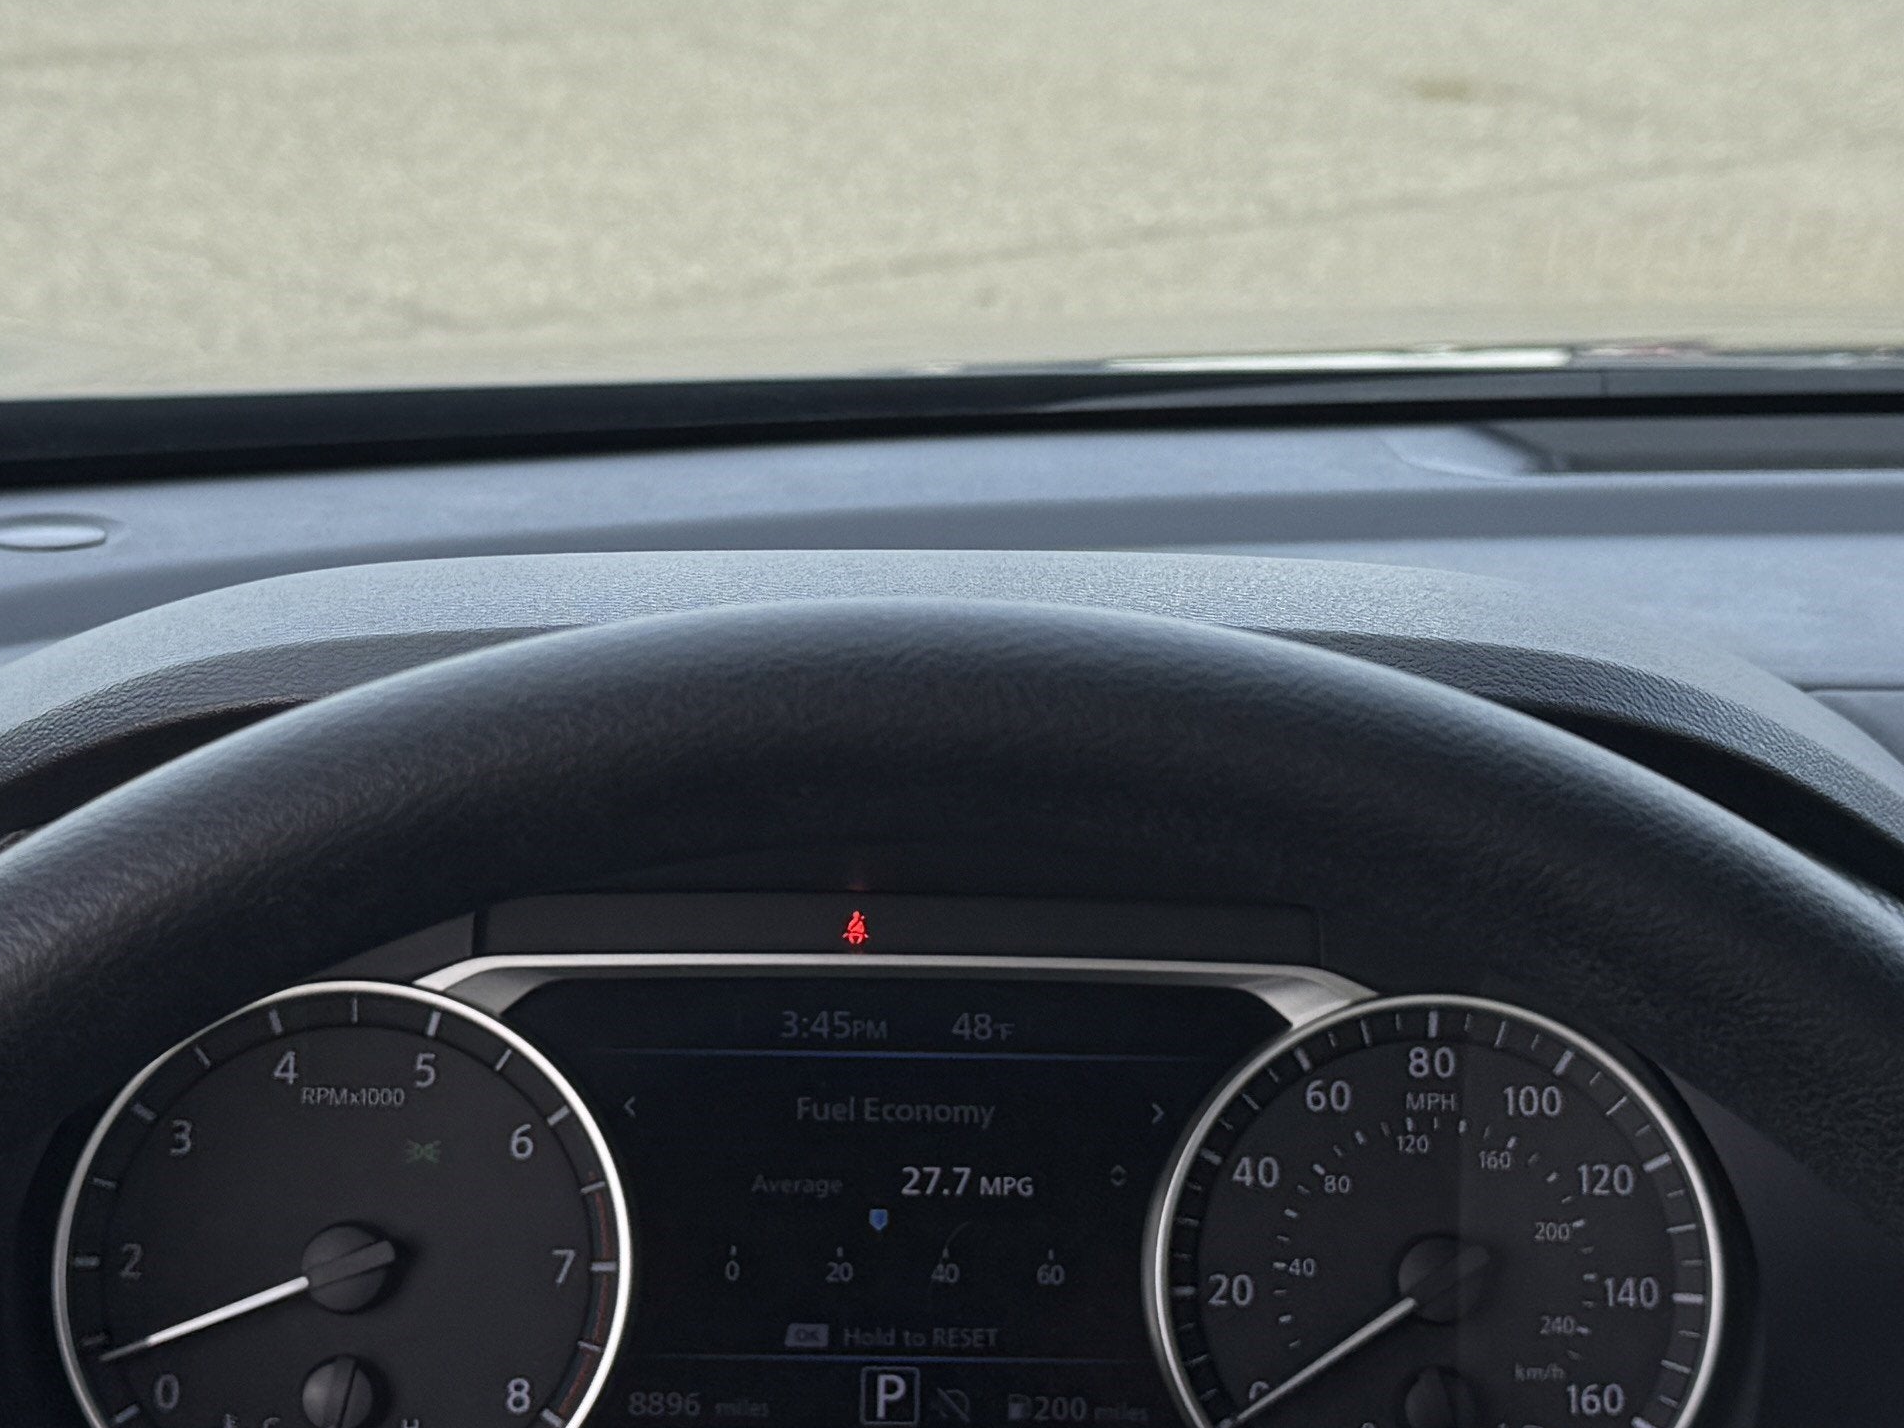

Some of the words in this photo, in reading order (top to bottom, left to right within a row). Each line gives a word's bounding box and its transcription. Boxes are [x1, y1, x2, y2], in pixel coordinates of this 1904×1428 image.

[273, 1050, 298, 1085] 4
[415, 1052, 436, 1087] 5
[1408, 1046, 1457, 1078] 80
[301, 1086, 406, 1106] RPMx1000
[1306, 1080, 1352, 1113] 60
[1406, 1092, 1457, 1112] MPH
[1503, 1085, 1562, 1117] 100
[796, 1097, 855, 1122] Fuel
[864, 1098, 995, 1129] Economy
[170, 1119, 192, 1156] 3
[510, 1124, 534, 1159] 6
[1396, 1134, 1430, 1155] 120
[1232, 1157, 1280, 1189] 40
[1479, 1149, 1512, 1171] 160
[752, 1173, 843, 1196] Average
[901, 1167, 971, 1197] 27.7
[980, 1176, 1034, 1198] MPG
[1323, 1174, 1351, 1196] 80
[1578, 1164, 1635, 1197] 120
[1534, 1222, 1572, 1243] 200
[120, 1243, 144, 1280] 2
[552, 1249, 576, 1285] 7
[725, 1261, 741, 1282] 0
[826, 1262, 854, 1283] 20
[933, 1264, 961, 1285] 40
[1036, 1265, 1065, 1286] 60
[1288, 1257, 1318, 1278] 40
[1208, 1274, 1253, 1306] 20
[1604, 1276, 1660, 1309] 140
[843, 1327, 895, 1347] Hold
[903, 1330, 927, 1347] to
[932, 1327, 999, 1348] RESET
[1540, 1316, 1576, 1337] 240
[1514, 1361, 1565, 1383] km/h
[153, 1373, 180, 1410] 0
[506, 1378, 532, 1413] 8
[876, 1374, 907, 1420] P
[1566, 1383, 1626, 1416] 160
[1033, 1396, 1087, 1422] 200
